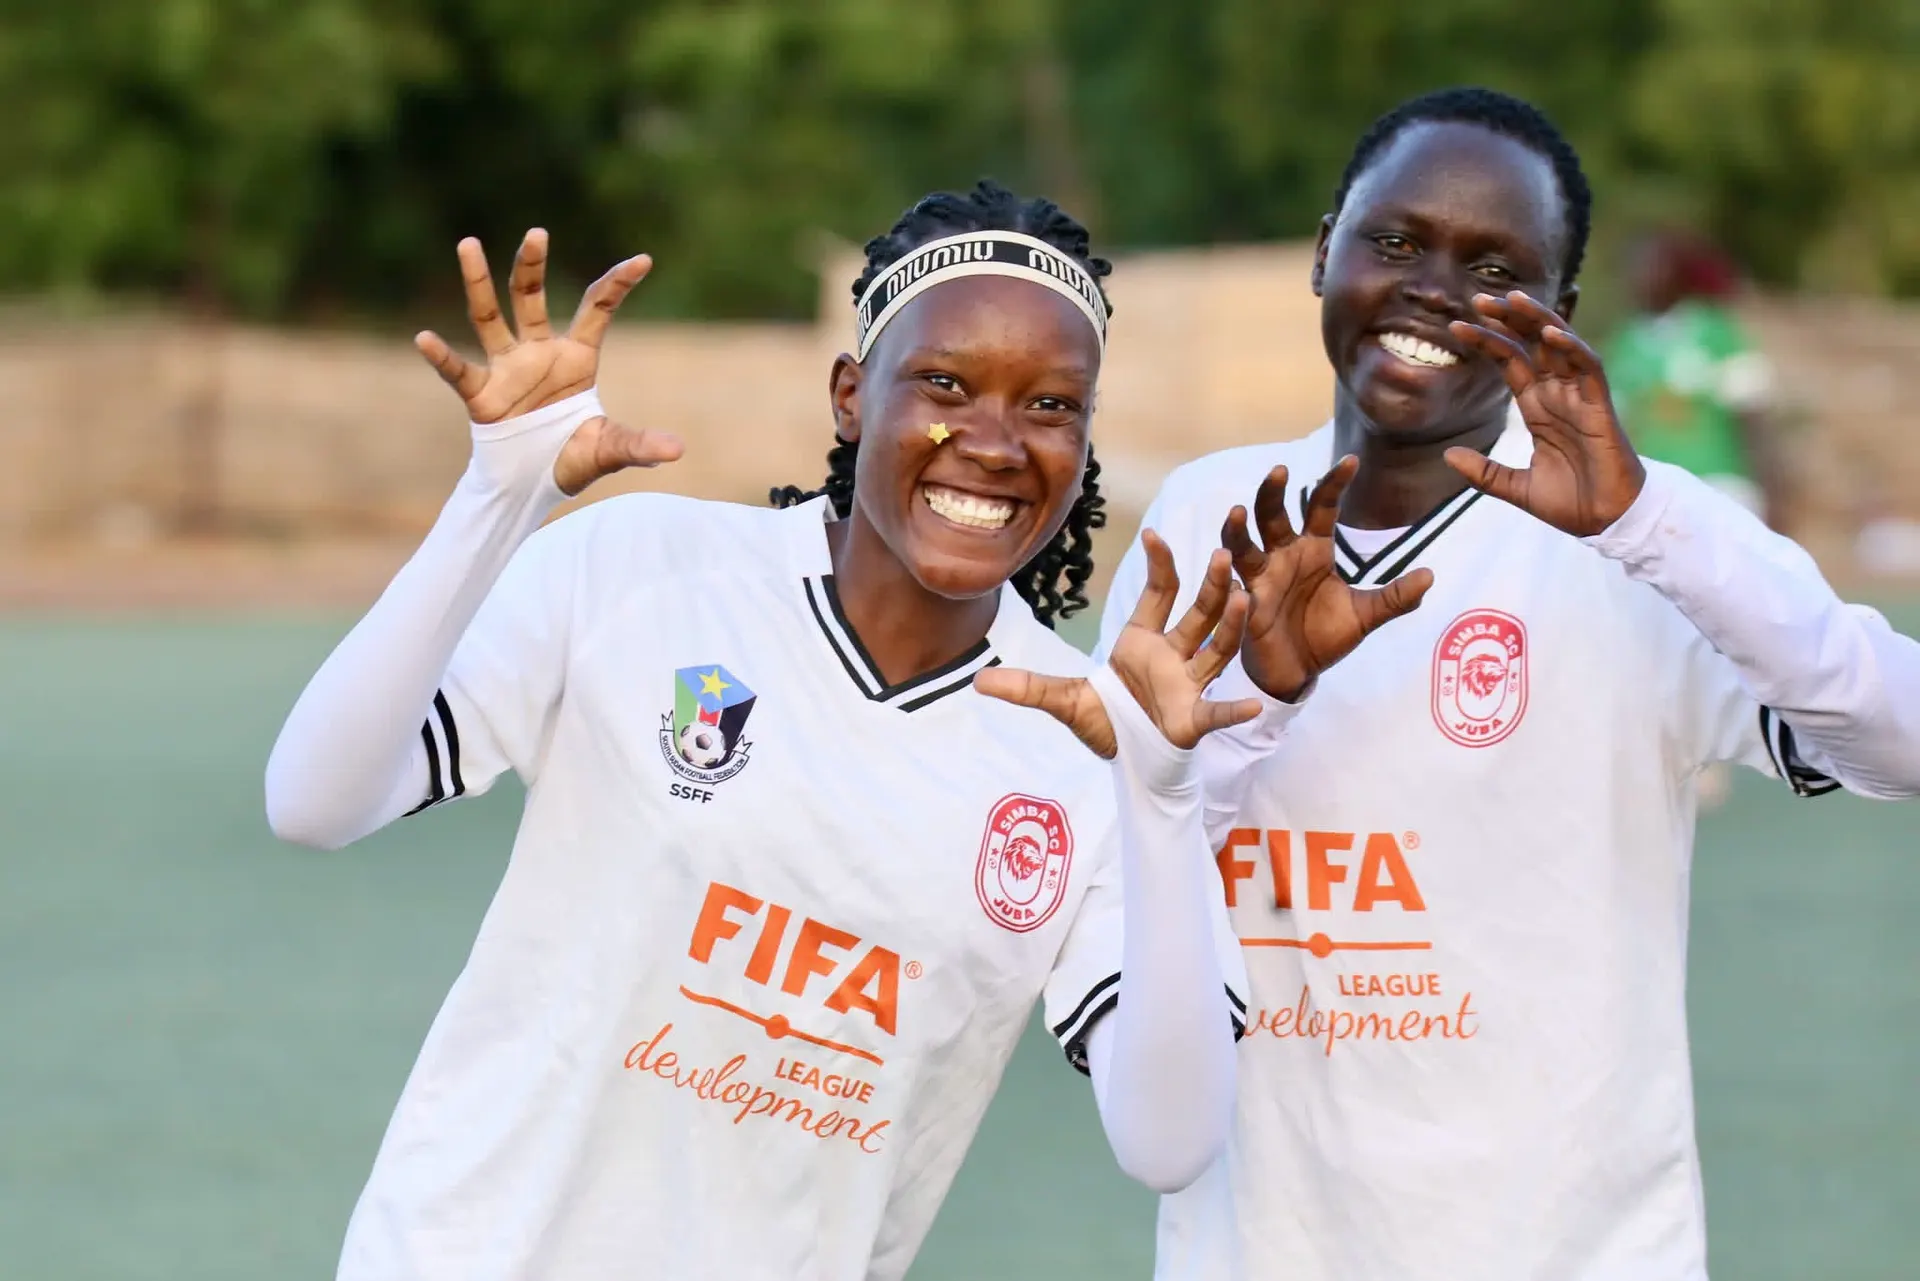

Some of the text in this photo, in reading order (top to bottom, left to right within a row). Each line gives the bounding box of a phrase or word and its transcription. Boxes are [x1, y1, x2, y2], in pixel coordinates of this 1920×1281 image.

[1448, 623, 1519, 656] SIMBA SC
[1455, 718, 1503, 735] JUBA
[684, 767, 712, 781] FOOTBALL
[713, 758, 745, 780] FEDERATION
[669, 783, 714, 804] SSFF
[1001, 805, 1060, 850] SIMBA SC
[993, 897, 1036, 920] JUBA
[1338, 973, 1441, 997] LEAGUE
[1244, 984, 1479, 1057] velopment
[624, 1022, 891, 1153] development
[774, 1057, 875, 1104] LEAGUE
